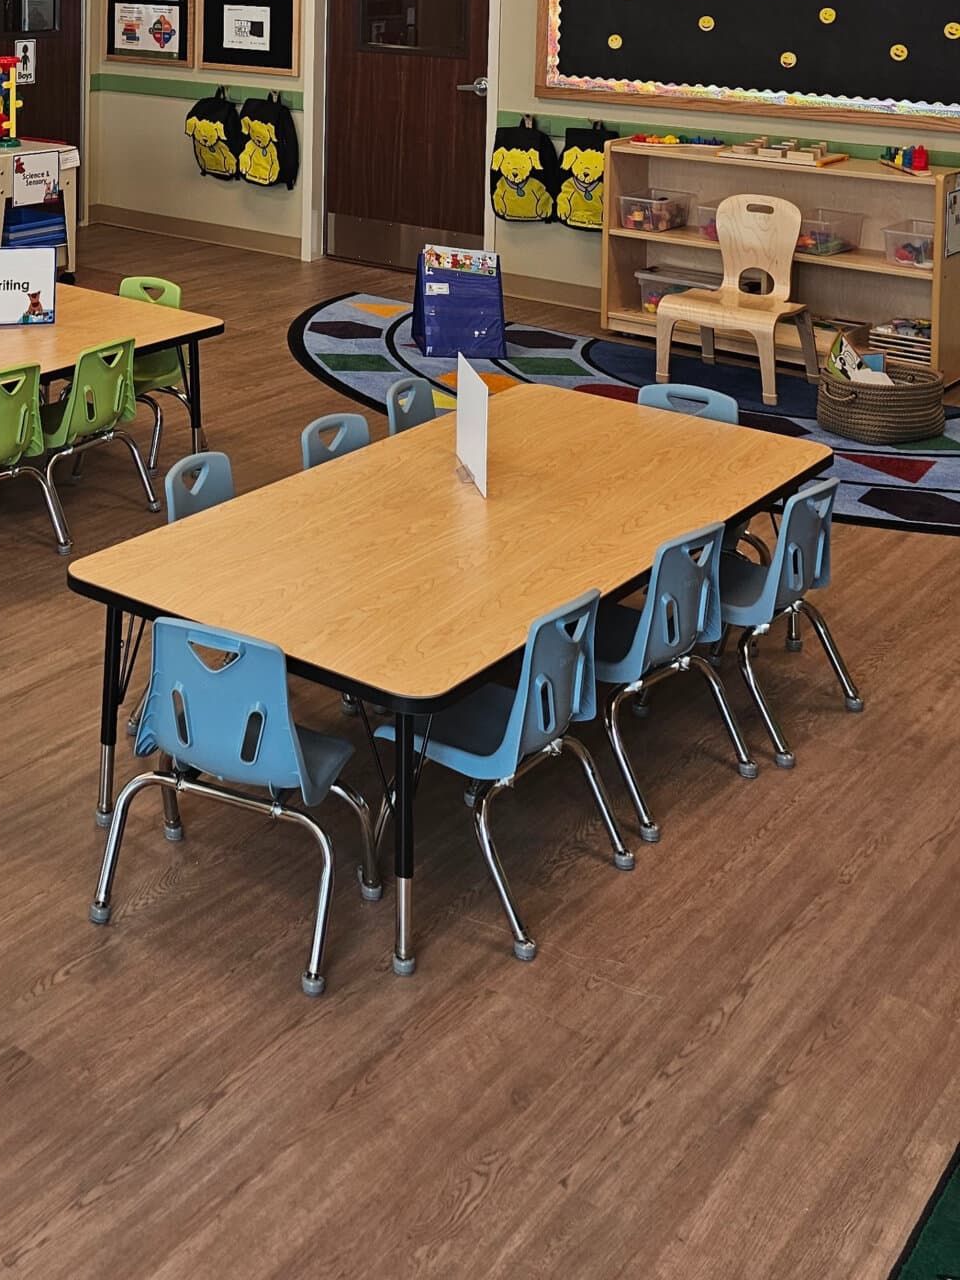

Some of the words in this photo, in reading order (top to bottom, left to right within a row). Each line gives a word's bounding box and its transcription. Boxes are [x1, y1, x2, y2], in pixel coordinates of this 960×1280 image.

[17, 71, 33, 81] Boys
[22, 171, 44, 180] Science
[25, 179, 46, 187] Sensory
